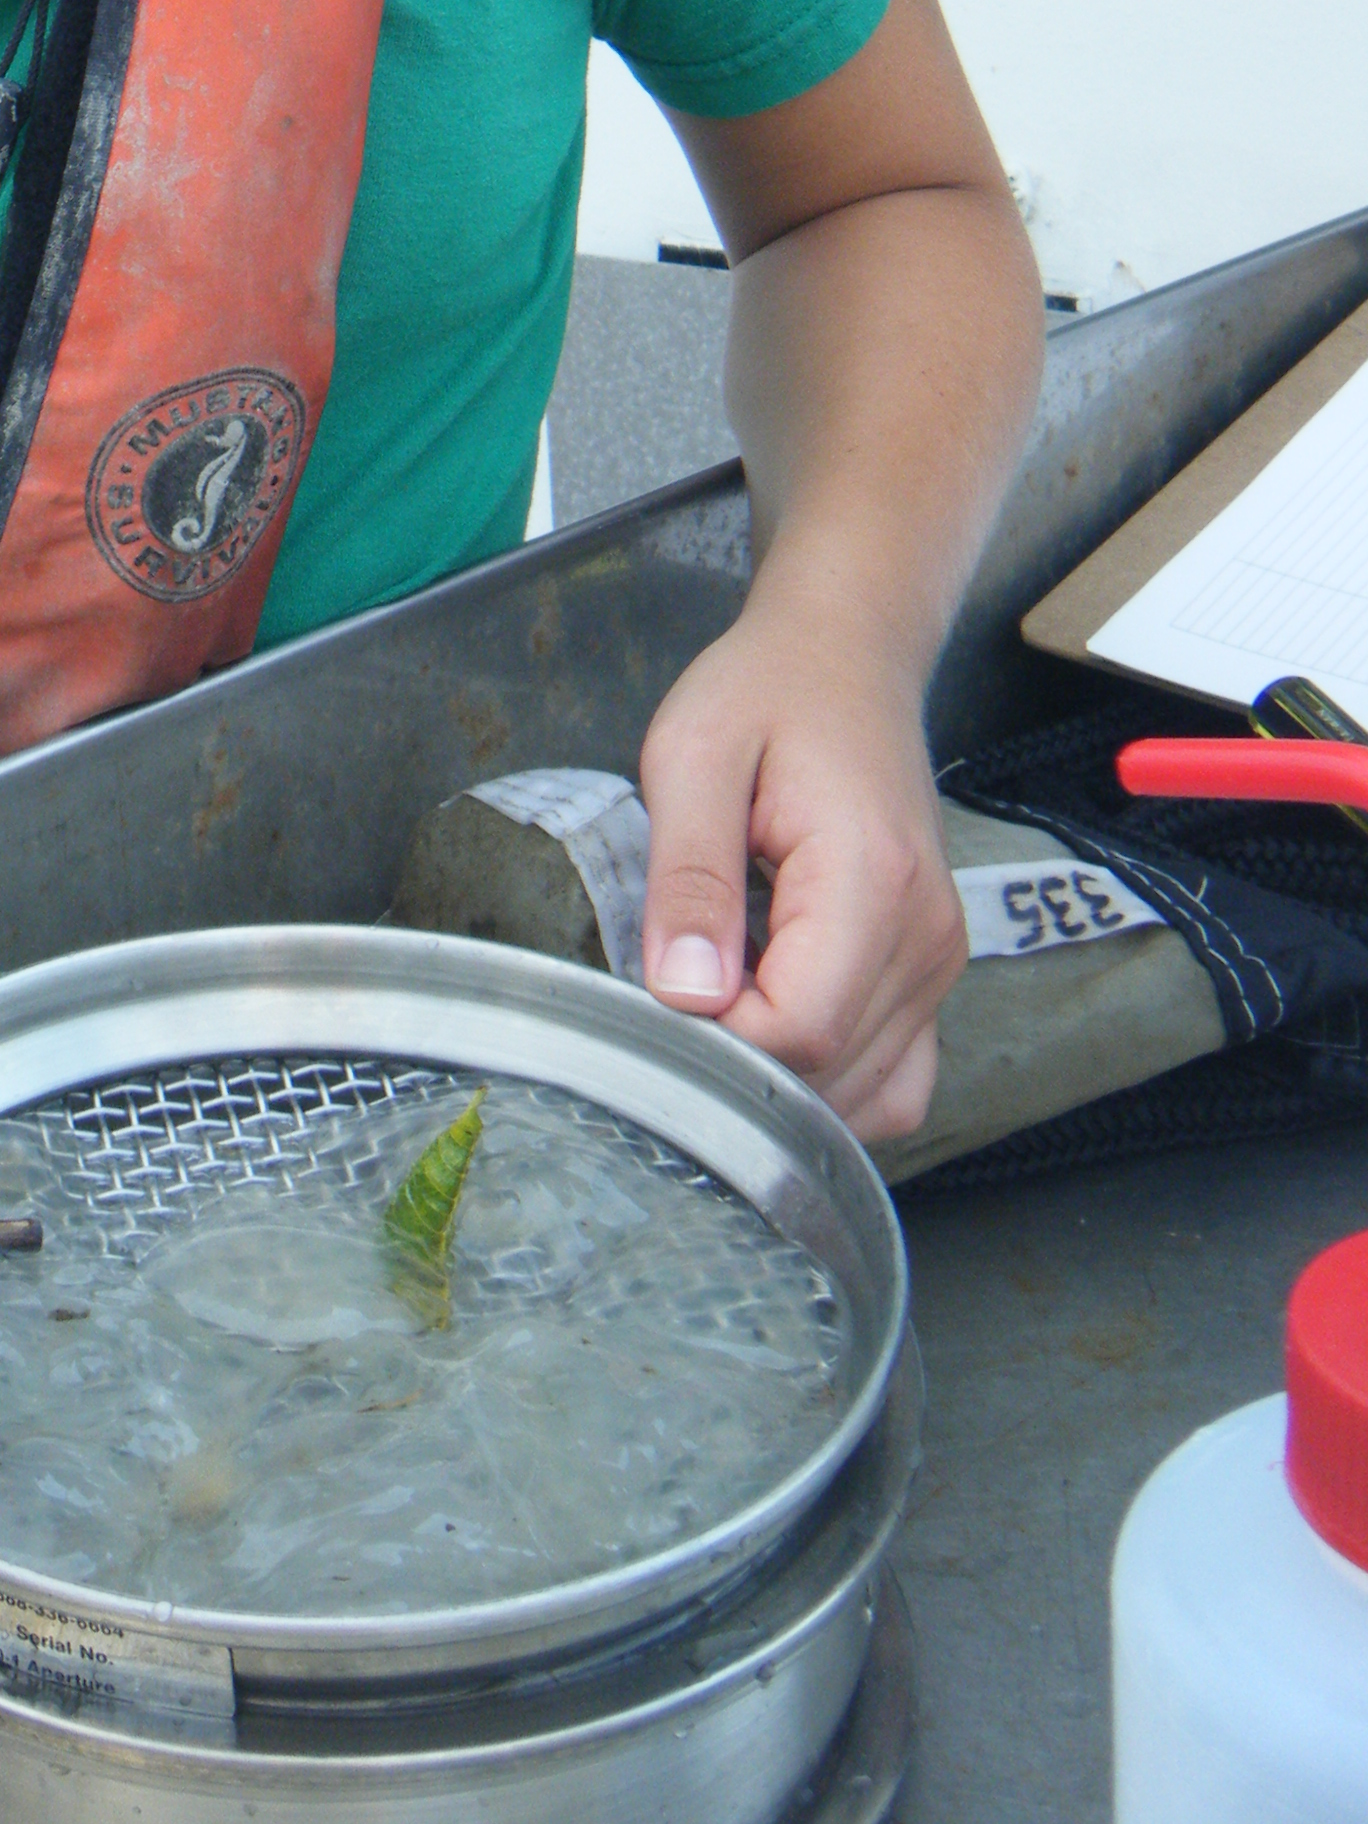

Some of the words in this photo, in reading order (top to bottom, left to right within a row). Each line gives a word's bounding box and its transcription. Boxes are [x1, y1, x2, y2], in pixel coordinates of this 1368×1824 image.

[128, 382, 292, 464] MUSTANG
[107, 484, 277, 585] SURVIVAL
[16, 1623, 72, 1656] Serial
[79, 1643, 114, 1666] No.
